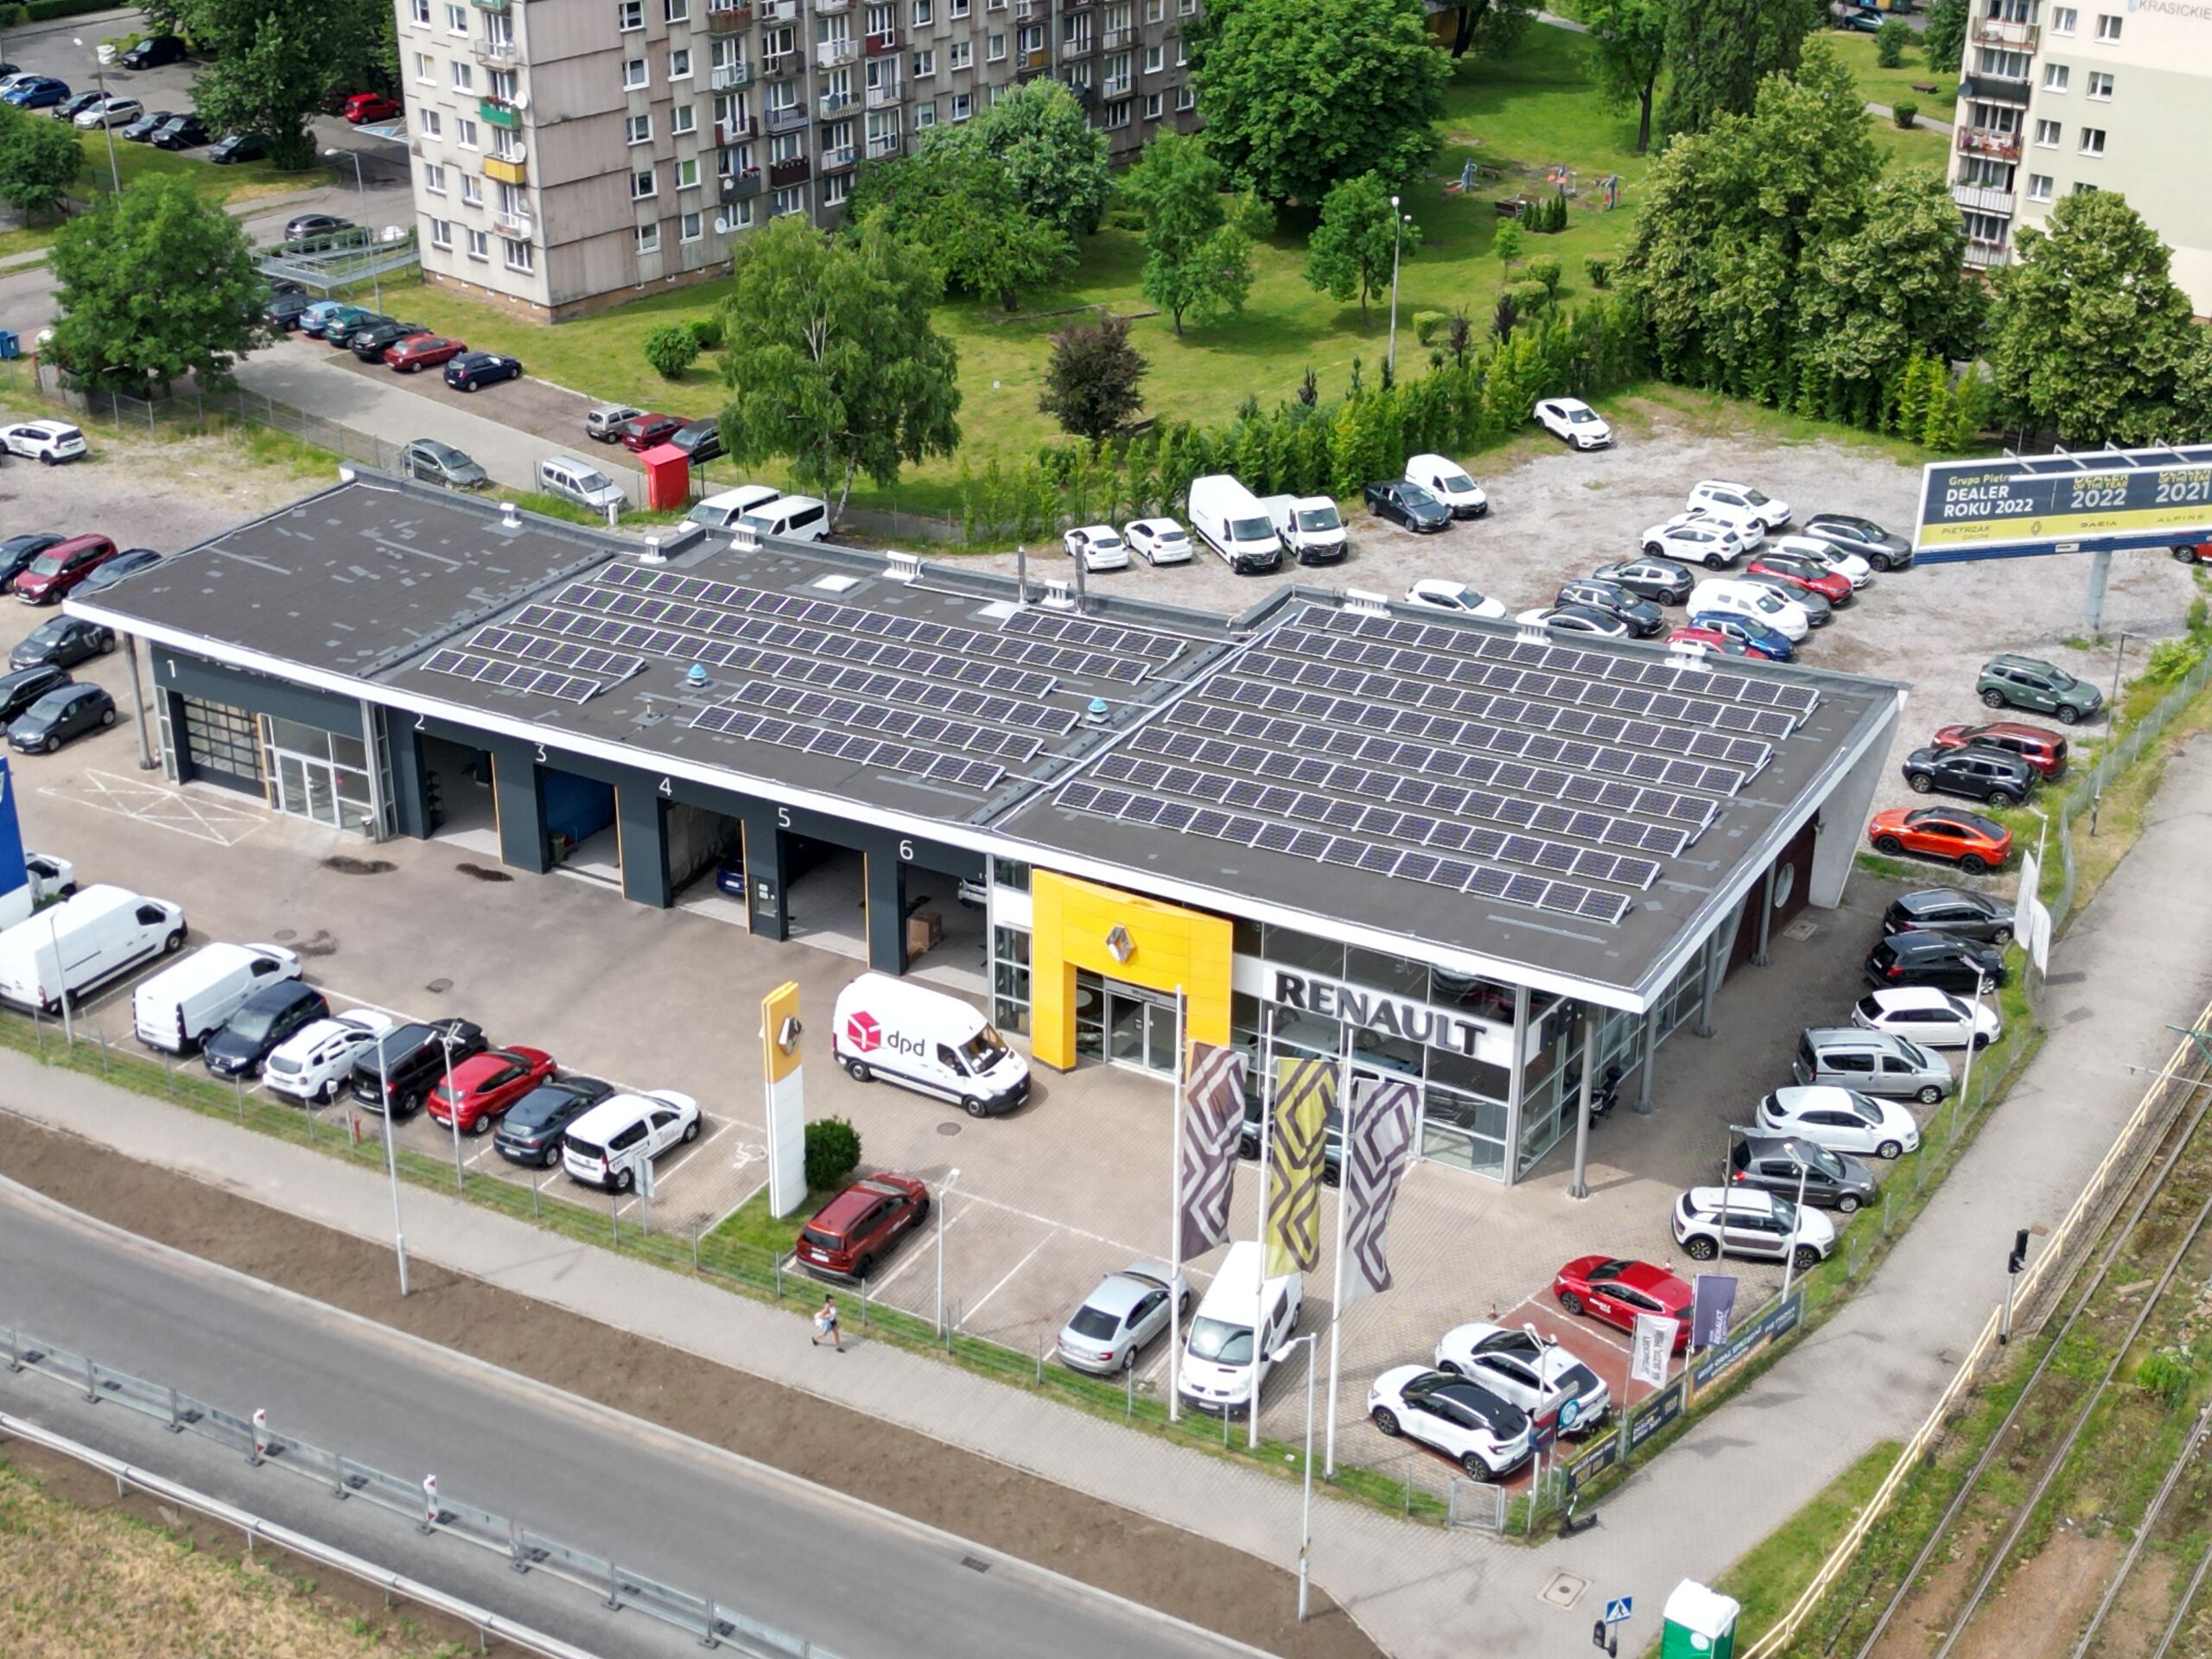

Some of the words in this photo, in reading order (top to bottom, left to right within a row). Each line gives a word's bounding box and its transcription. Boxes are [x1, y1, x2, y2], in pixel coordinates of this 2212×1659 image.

[1949, 476, 1980, 486] Grupa
[1983, 474, 2012, 483] Pietr
[1946, 486, 2010, 502] DEALER
[2070, 487, 2127, 508] 2022
[2155, 480, 2210, 503] 2021
[1943, 501, 1992, 518] ROKU
[1995, 499, 2034, 514] 2022
[2158, 514, 2204, 523] ALPINE
[166, 659, 176, 678] 1
[414, 715, 425, 730] 2
[535, 743, 547, 762] 3
[659, 778, 672, 796] 4
[778, 807, 791, 828] 5
[899, 840, 913, 861] 6
[1274, 970, 1487, 1056] RENAULT
[887, 1031, 925, 1057] dpd
